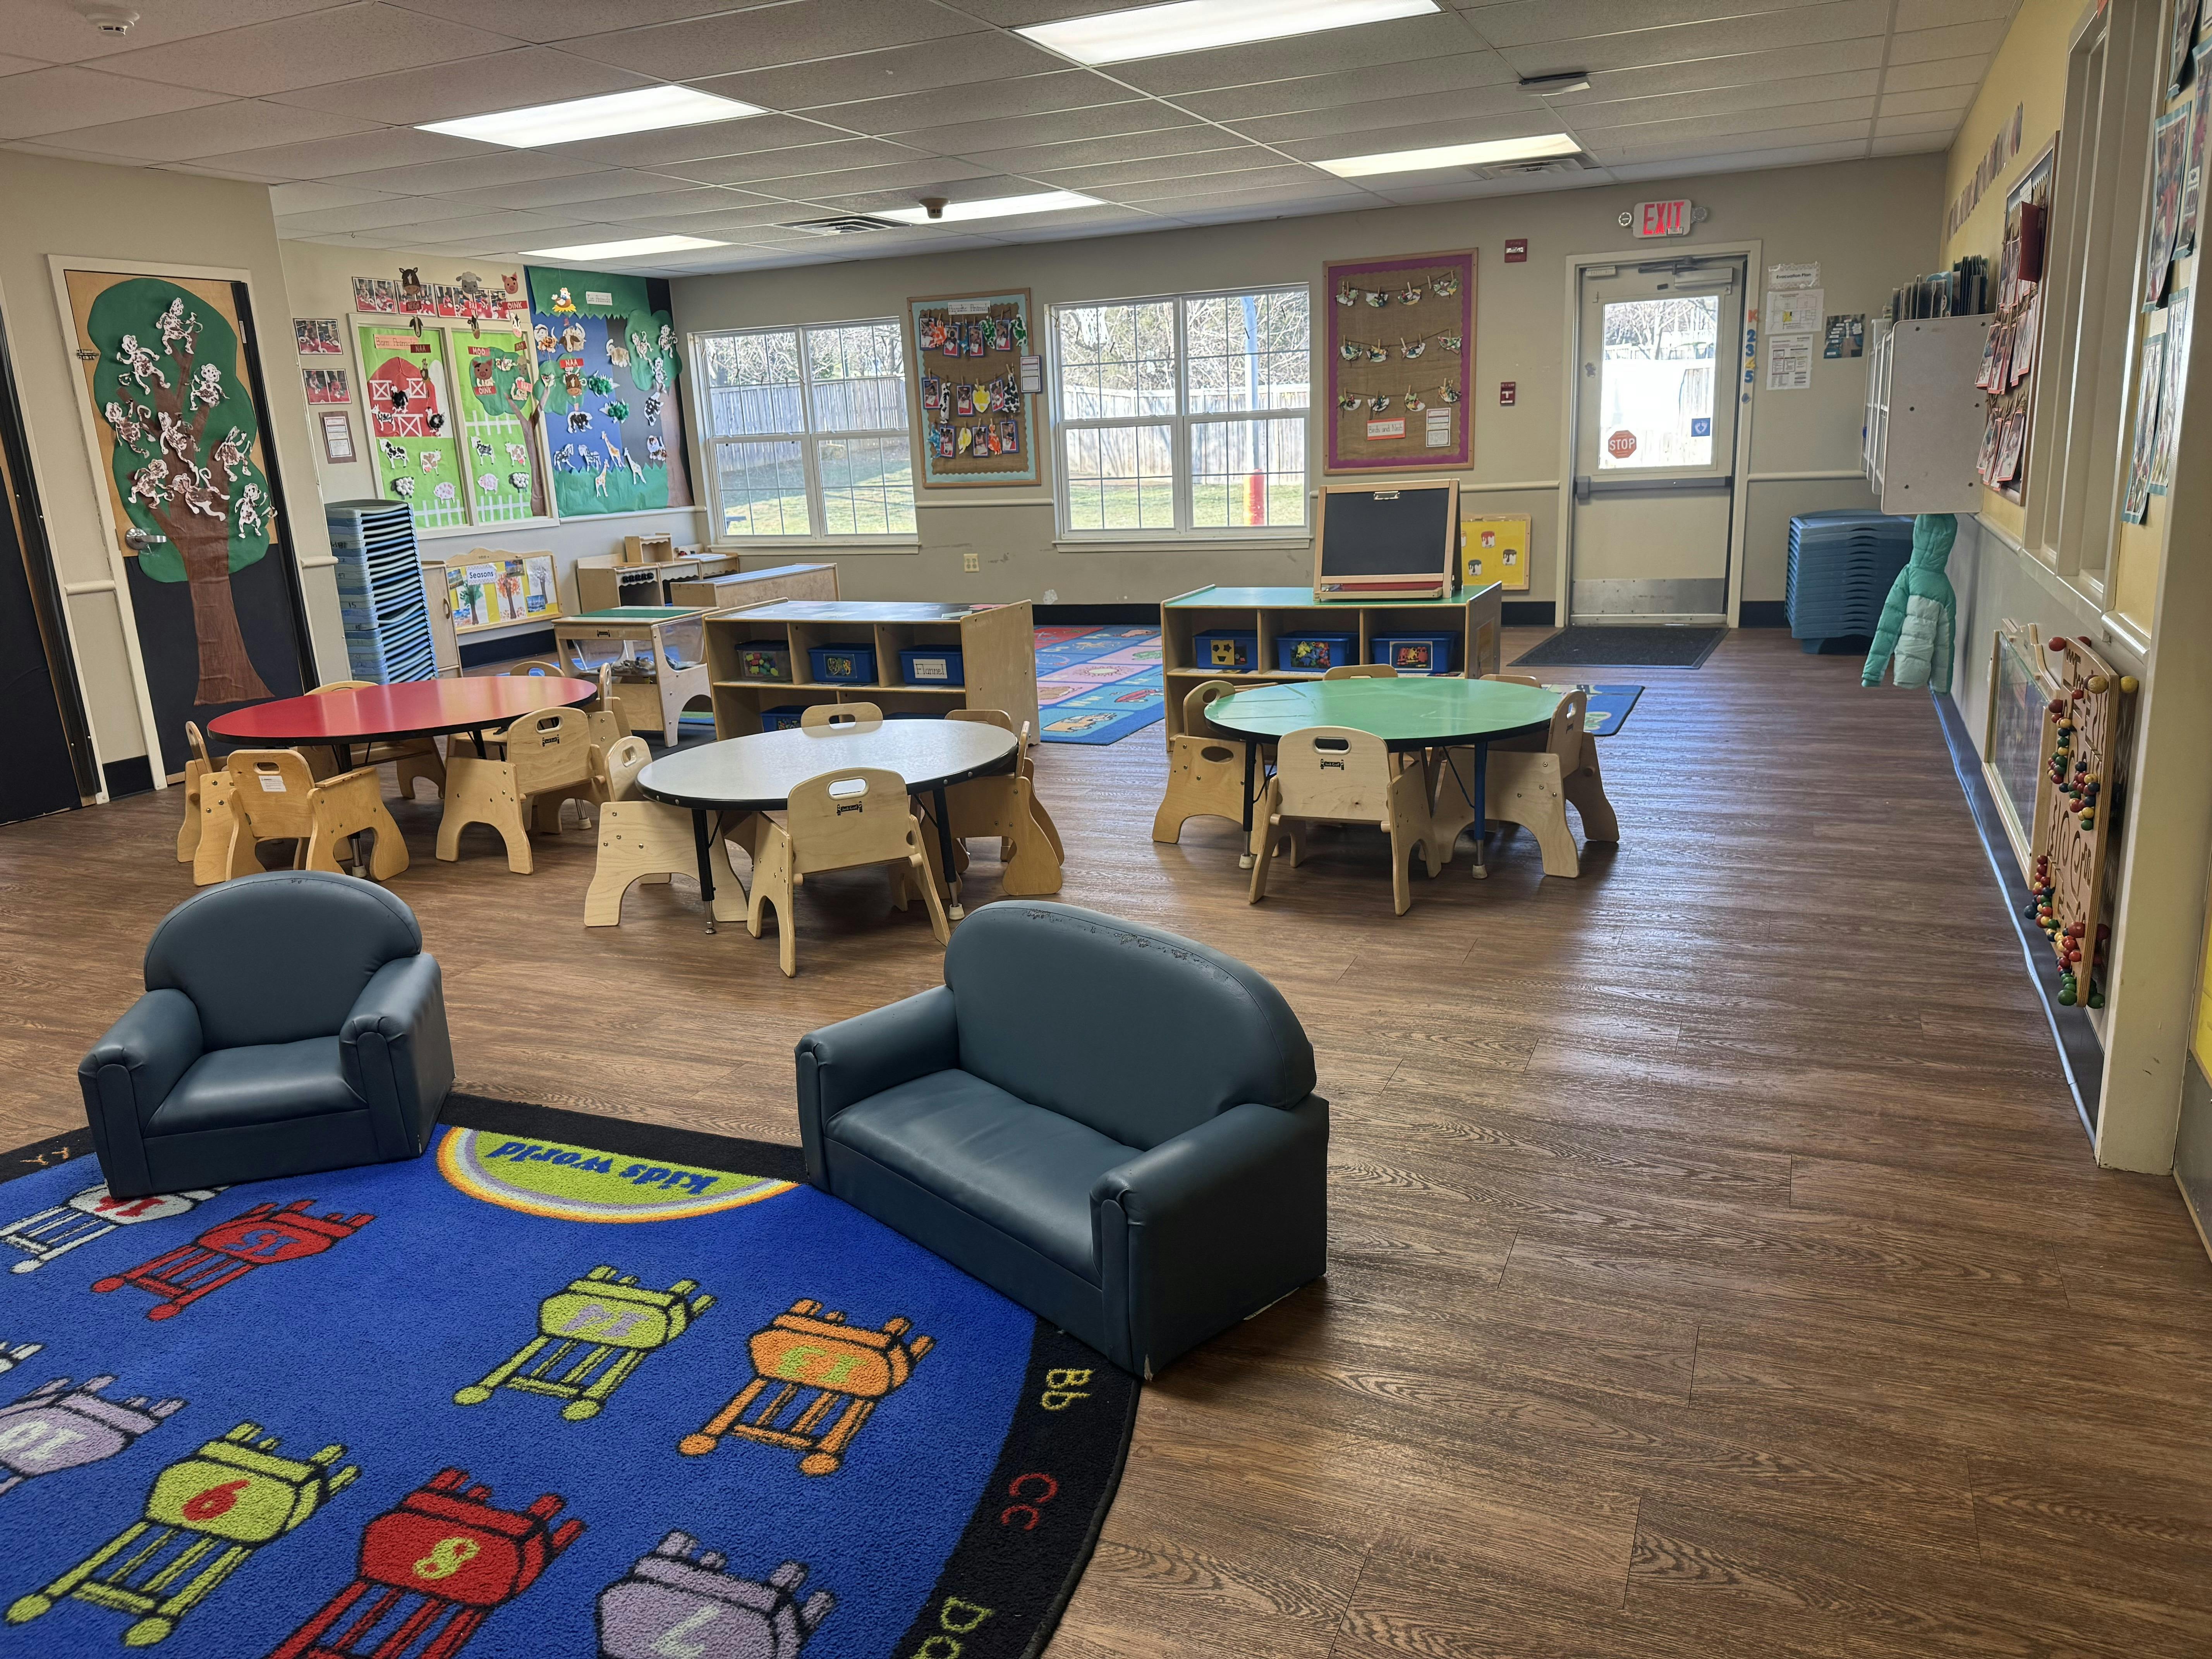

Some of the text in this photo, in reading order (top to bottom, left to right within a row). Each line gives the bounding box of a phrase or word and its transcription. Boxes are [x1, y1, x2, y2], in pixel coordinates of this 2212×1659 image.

[1642, 201, 1684, 235] EXIT
[1748, 309, 1759, 323] K
[1747, 329, 1756, 342] 2
[1746, 343, 1754, 357] 3
[1745, 358, 1756, 370] 4
[1744, 370, 1753, 383] 5
[478, 386, 492, 395] OINK
[1382, 424, 1390, 432] and
[1609, 438, 1635, 451] STOP
[915, 664, 944, 675] Flannel
[485, 1141, 720, 1195] kids world
[220, 1229, 301, 1256] 15
[559, 1304, 649, 1337] 14
[776, 1345, 869, 1385] 13
[1039, 1368, 1096, 1411] Bb
[1000, 1472, 1059, 1531] Cc
[412, 1536, 480, 1580] 8
